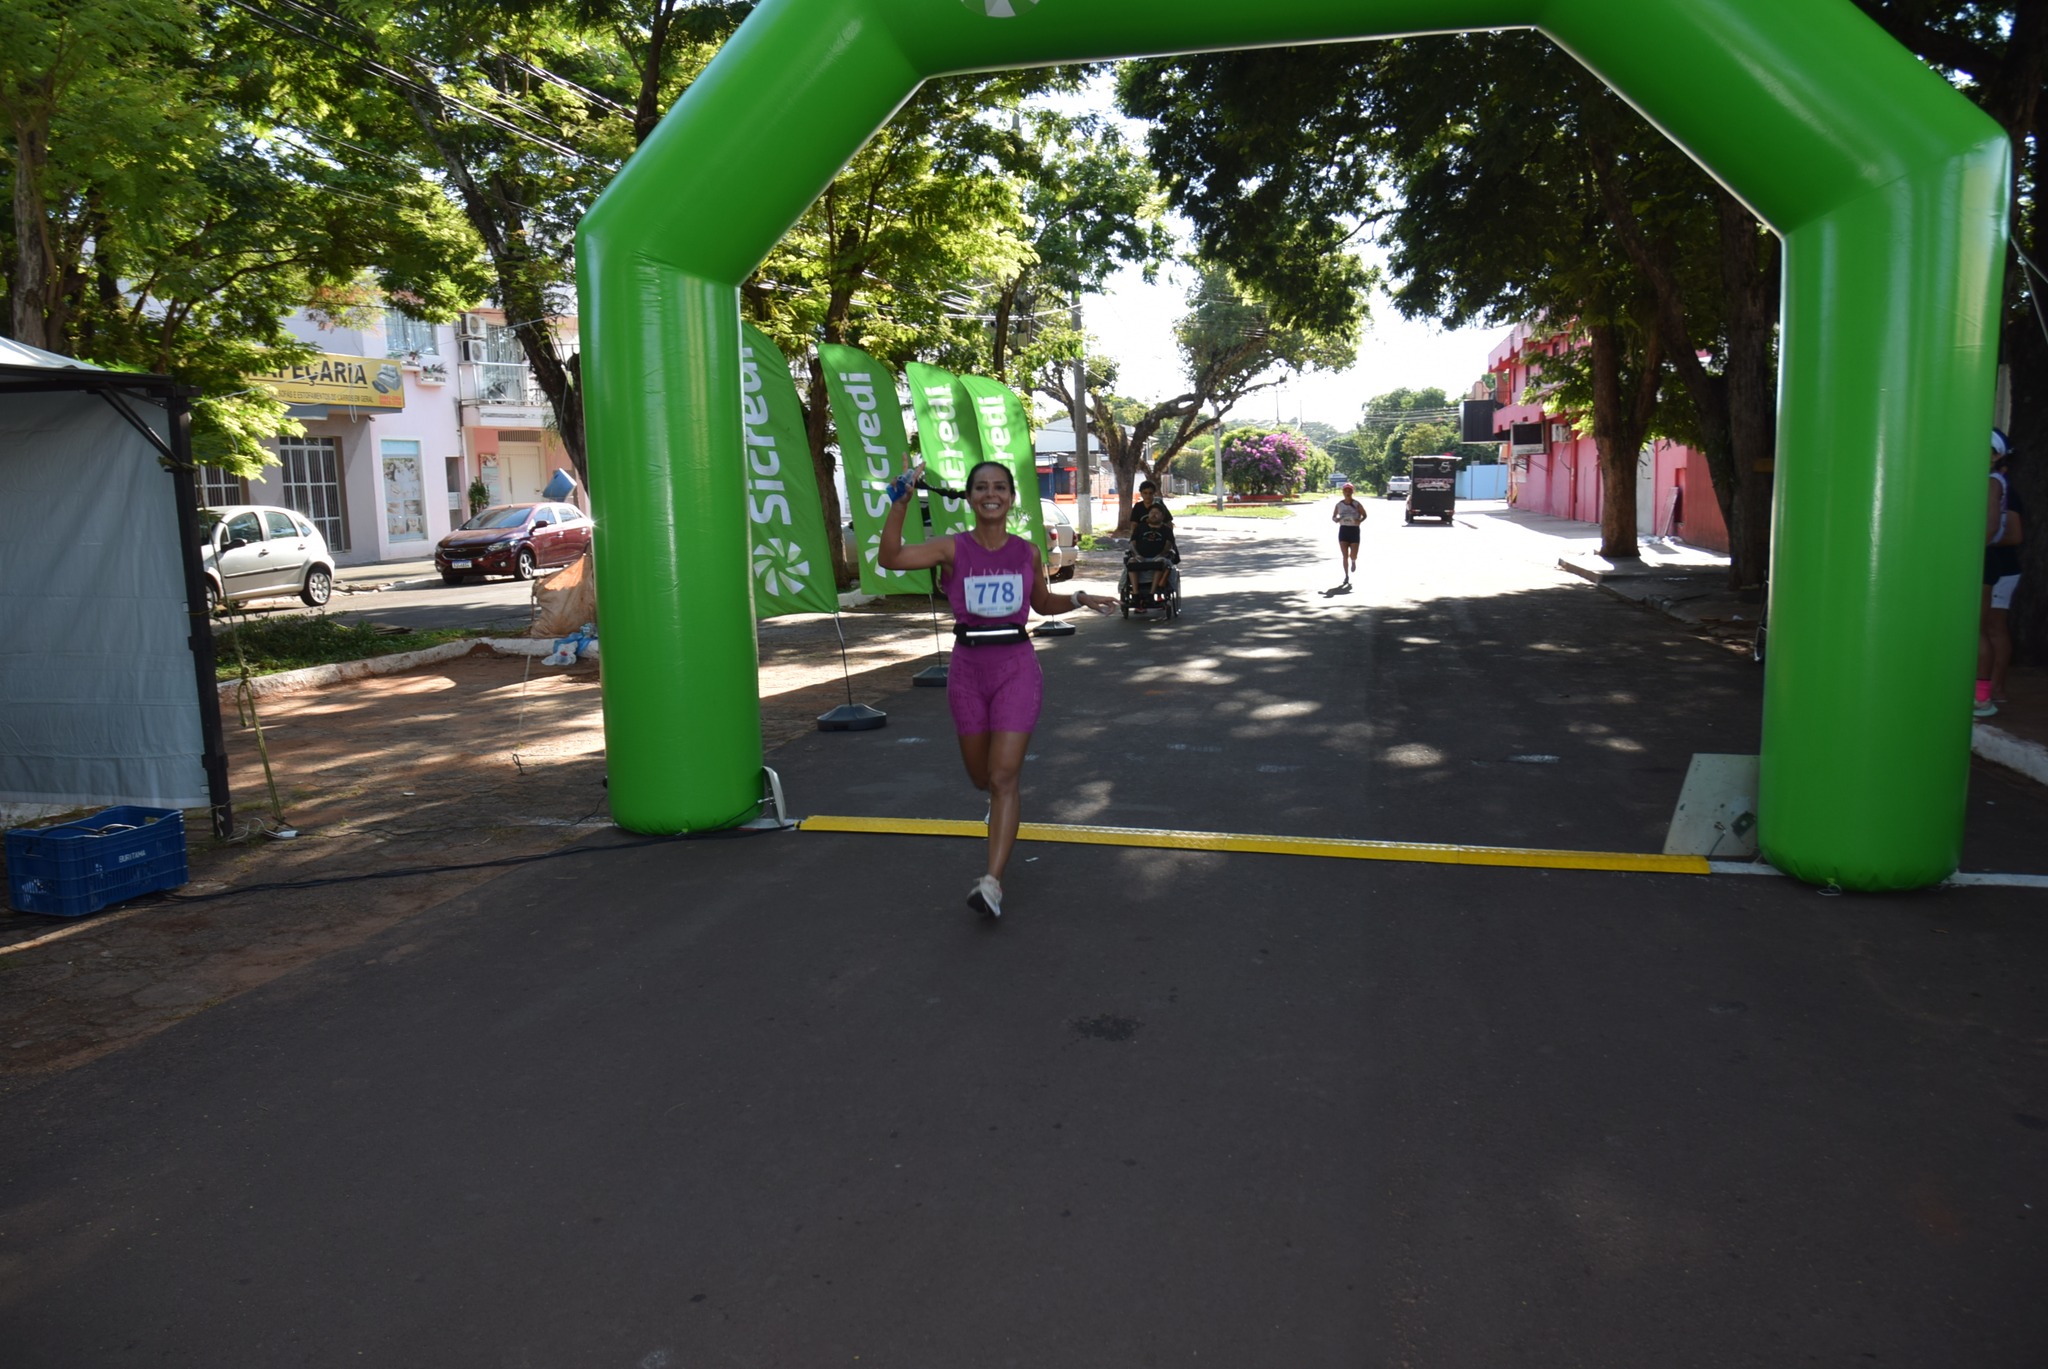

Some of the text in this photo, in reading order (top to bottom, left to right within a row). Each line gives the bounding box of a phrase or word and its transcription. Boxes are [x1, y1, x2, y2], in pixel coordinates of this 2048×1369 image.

[254, 360, 368, 386] PEÇARIA
[839, 372, 893, 518] Sicredi
[974, 581, 1015, 604] 778
